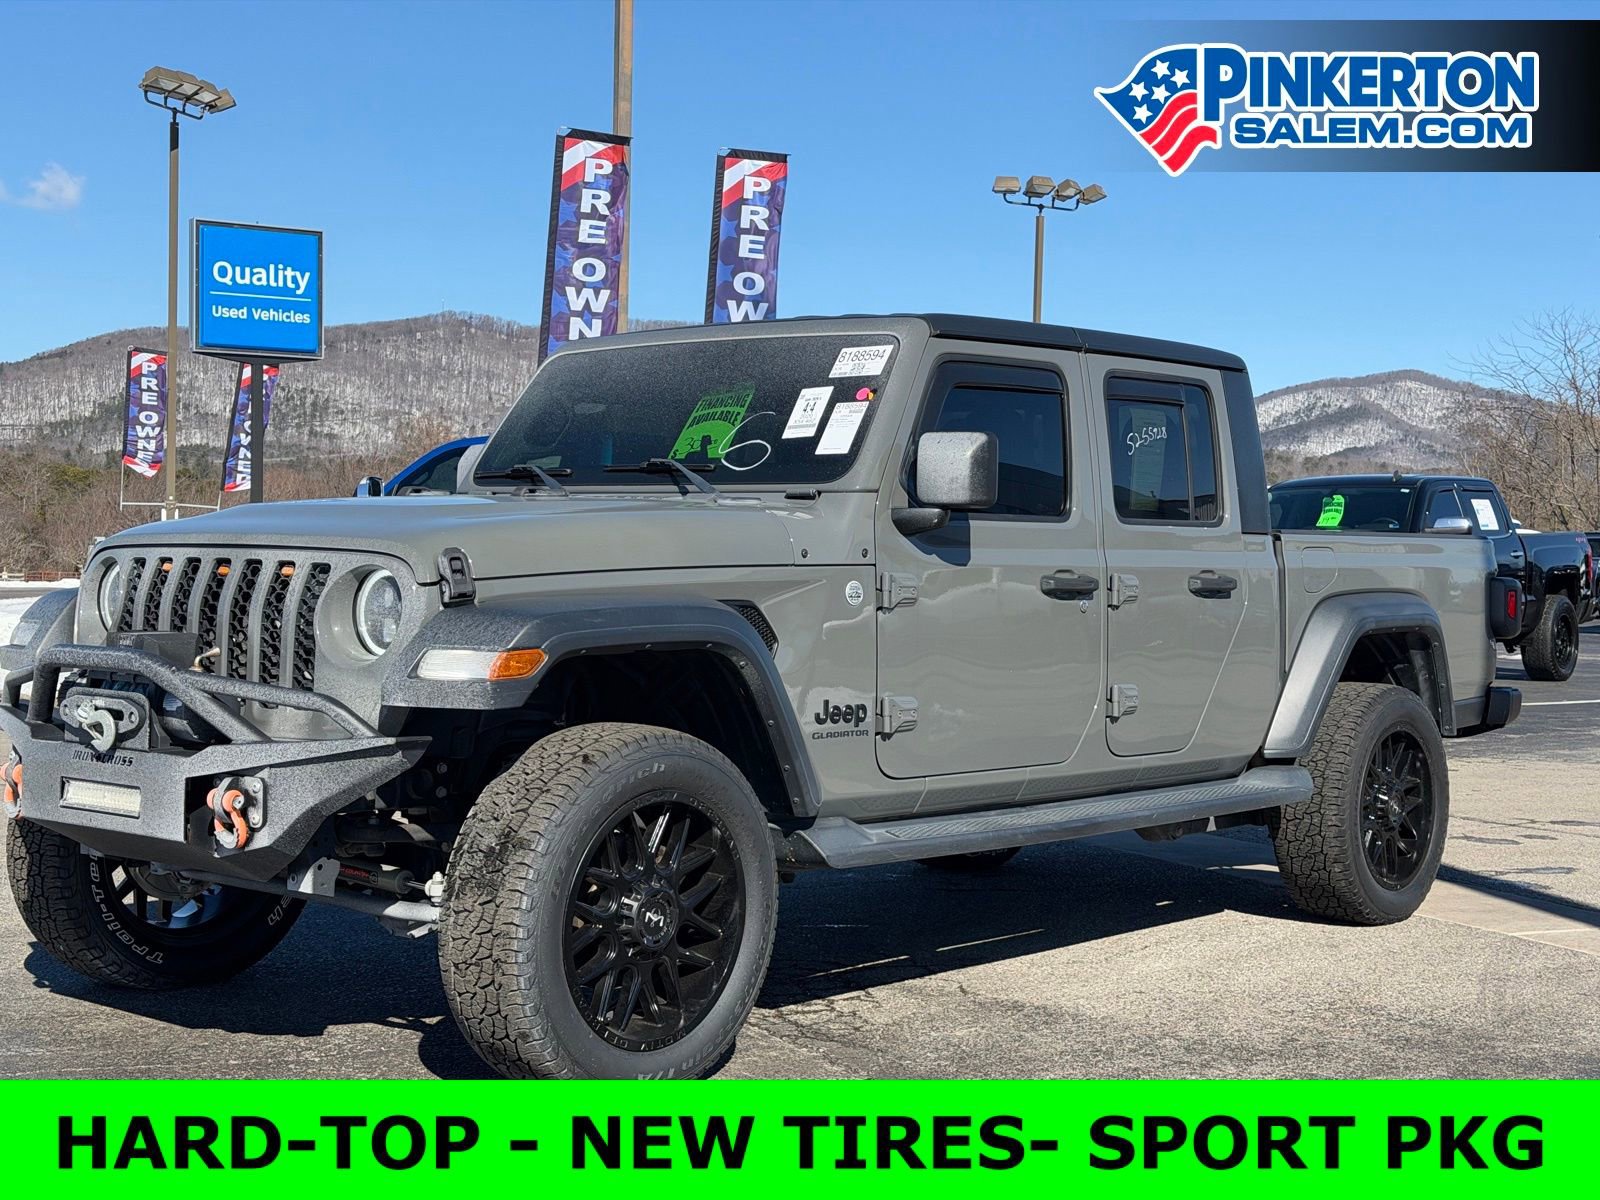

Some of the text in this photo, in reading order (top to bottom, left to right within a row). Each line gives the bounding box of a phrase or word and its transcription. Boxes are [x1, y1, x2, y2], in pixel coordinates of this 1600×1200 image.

[577, 157, 613, 244] PRE
[738, 175, 771, 260] PRE
[212, 261, 310, 295] Quality
[211, 304, 311, 325] Used Vehicles
[837, 348, 887, 363] 8188594
[140, 361, 159, 406] PRE
[685, 409, 742, 431] AVAILABLE
[814, 699, 868, 728] Jeep
[811, 729, 869, 740] GLADIATOR
